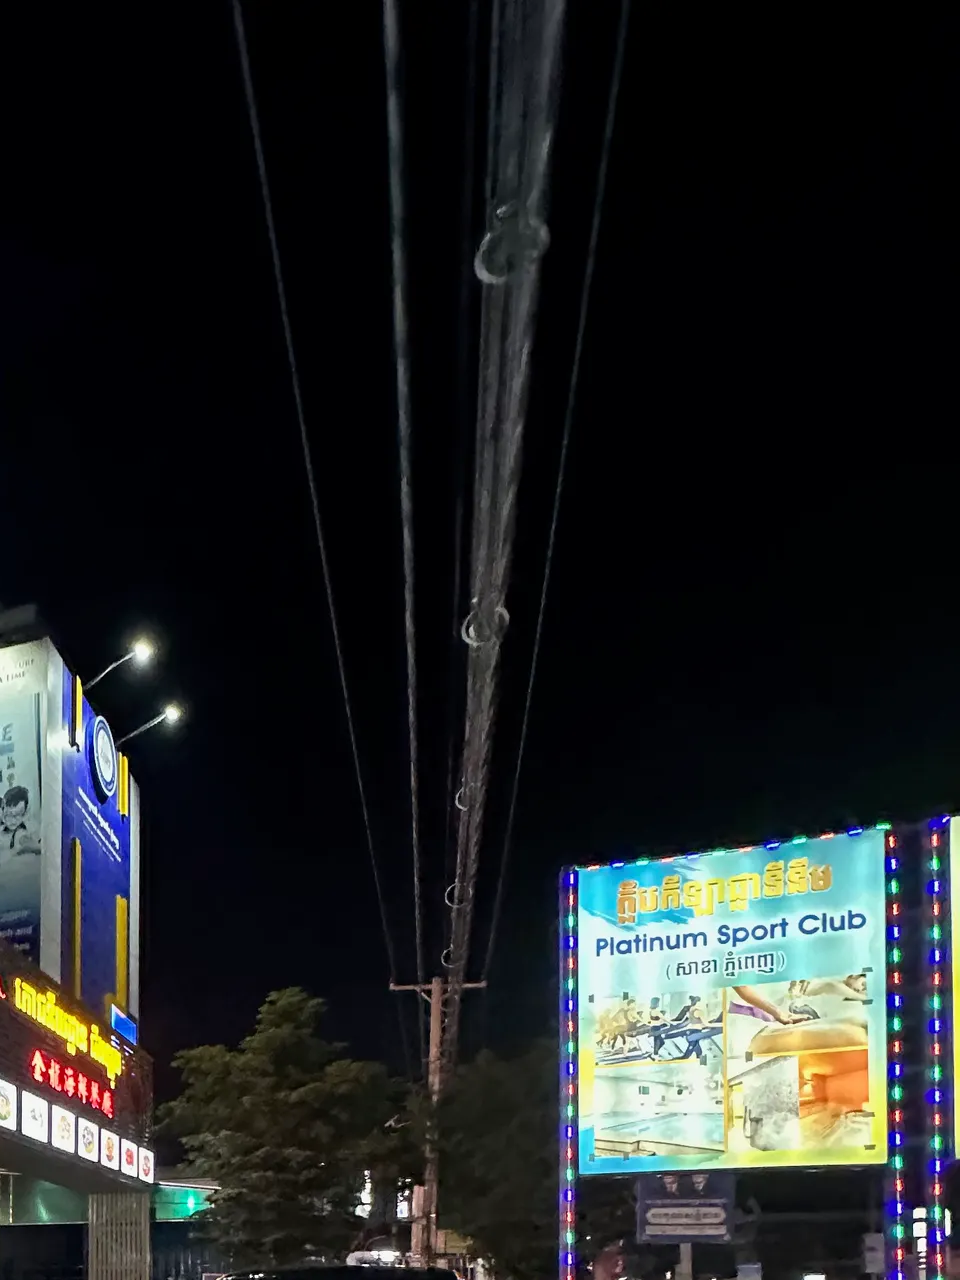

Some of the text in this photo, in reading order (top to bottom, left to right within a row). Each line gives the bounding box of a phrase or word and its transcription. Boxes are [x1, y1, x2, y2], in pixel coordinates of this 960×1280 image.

[596, 910, 866, 957] Platinum Sport Club
